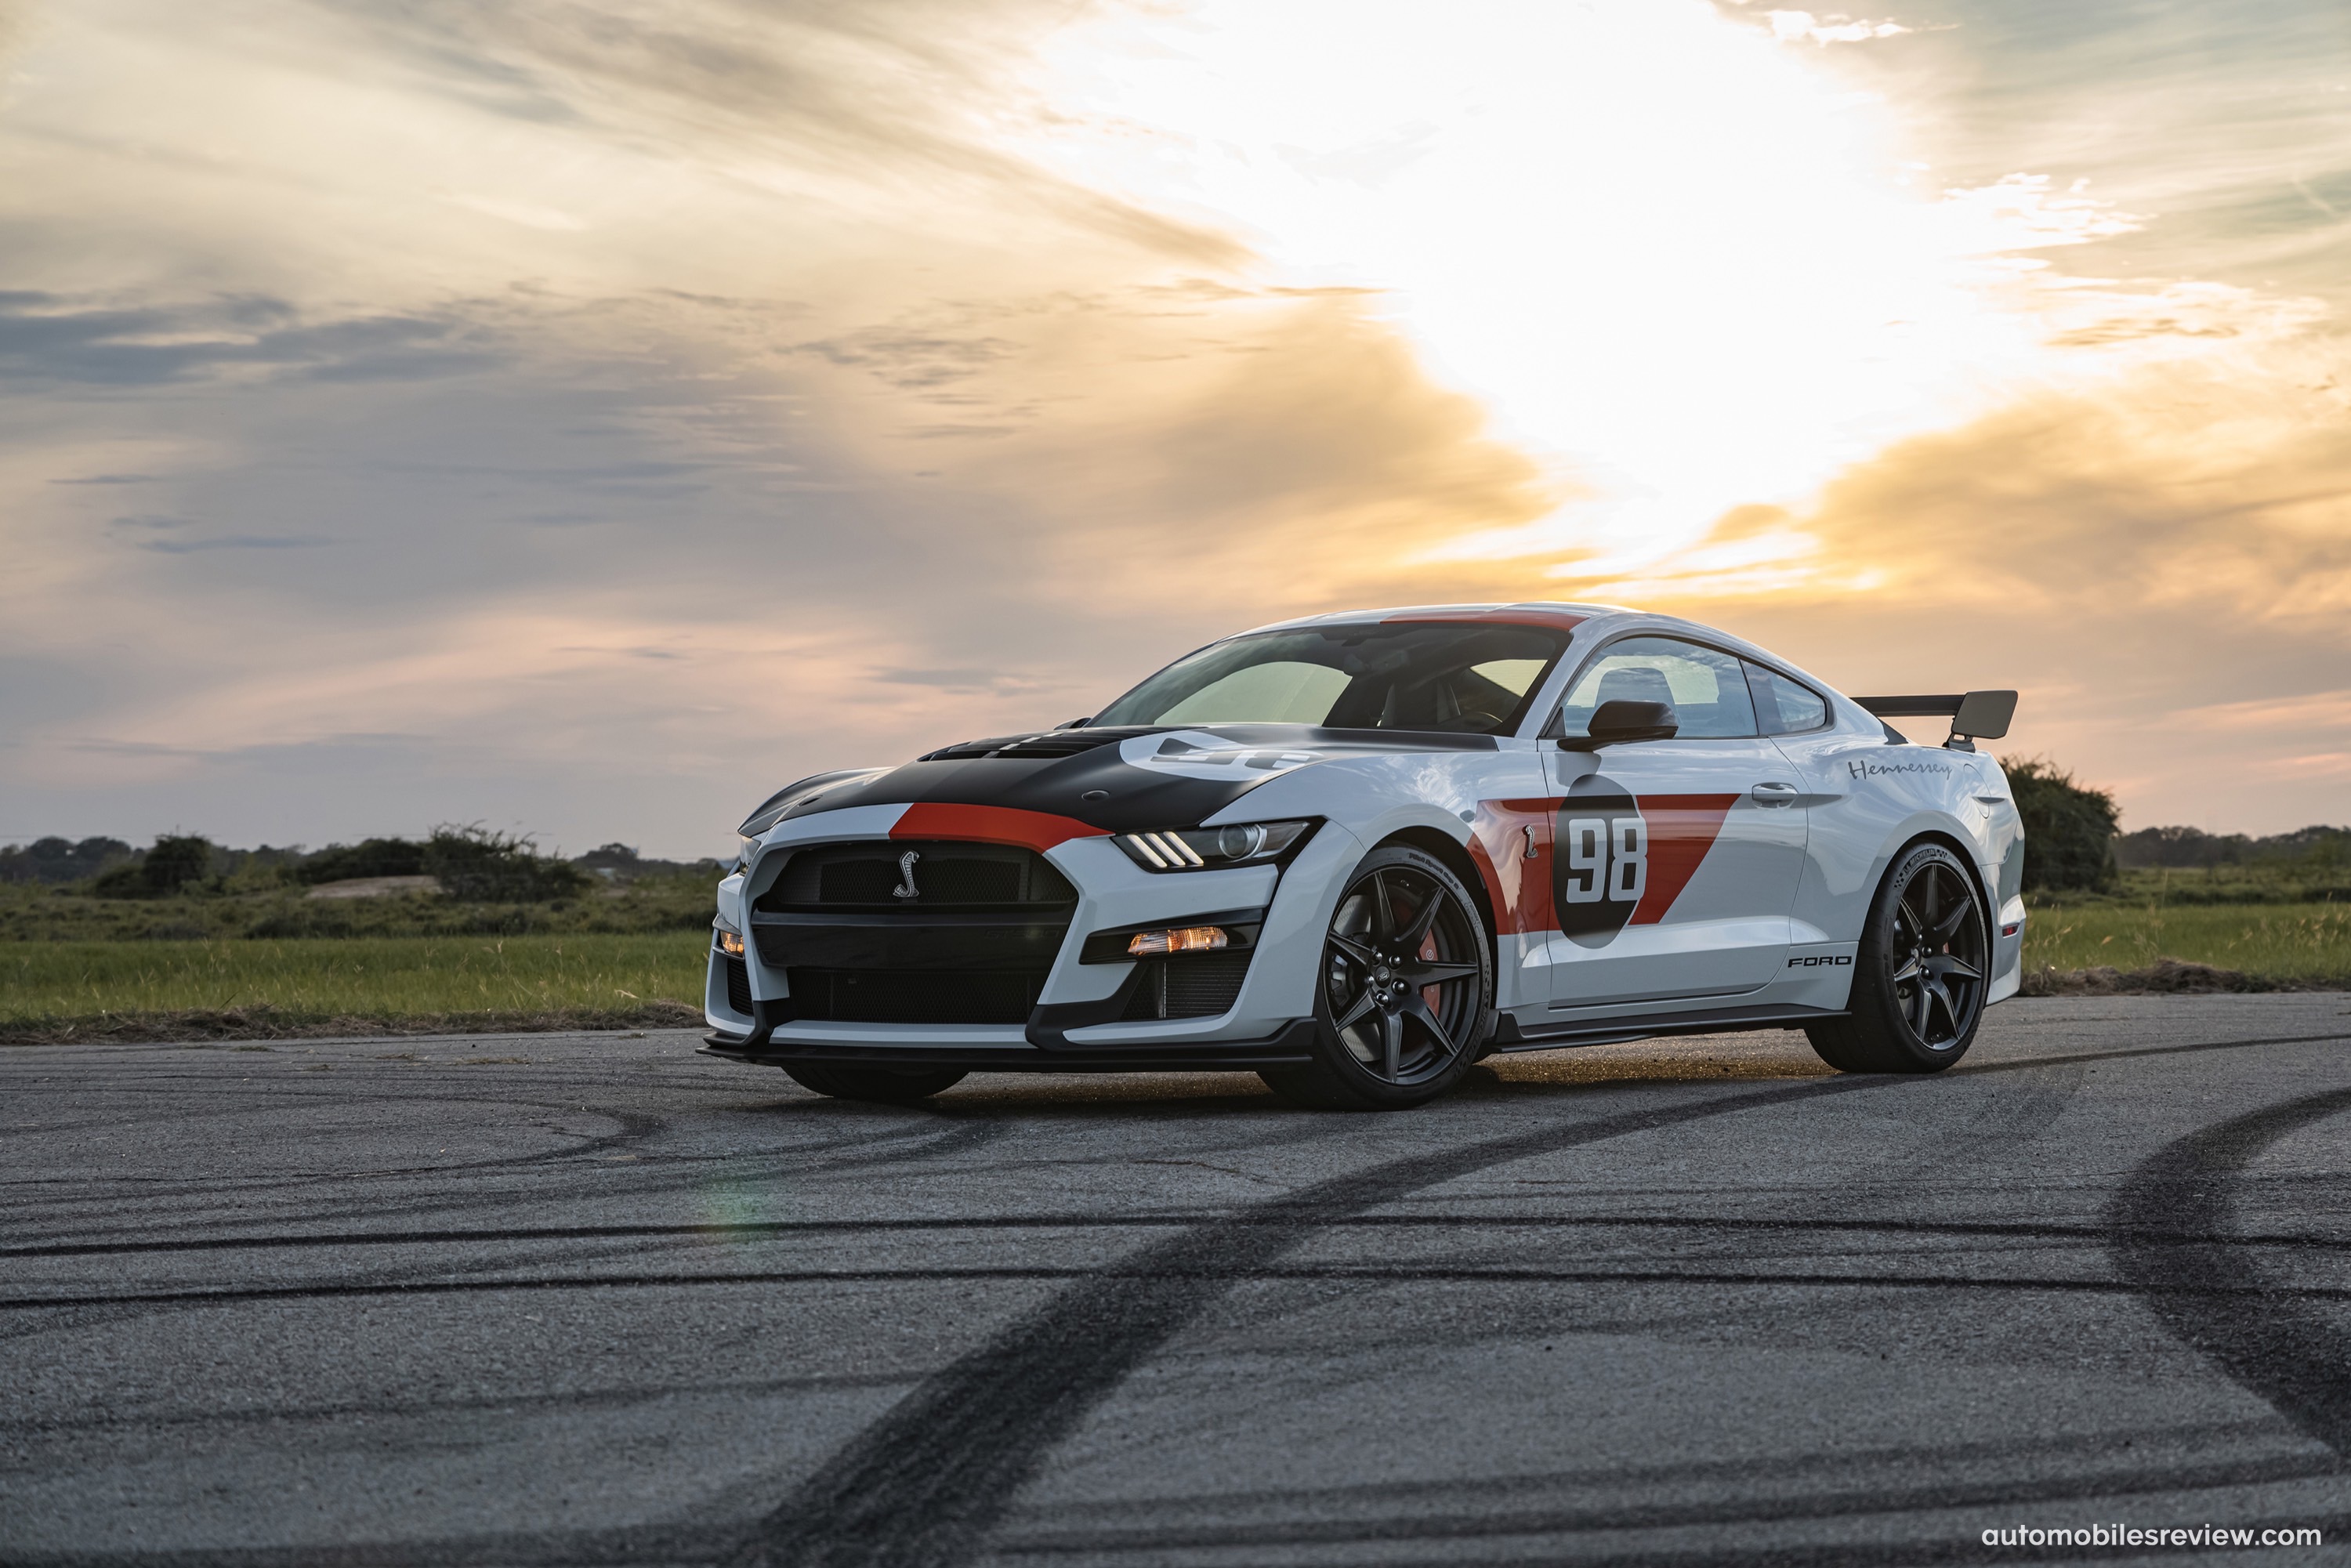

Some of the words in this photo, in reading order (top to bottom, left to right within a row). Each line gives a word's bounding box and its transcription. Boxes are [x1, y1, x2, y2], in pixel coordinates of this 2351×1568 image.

[1848, 760, 1952, 780] Hennessey
[1567, 818, 1648, 904] 98
[1909, 849, 1936, 867] MICHELIN
[1788, 956, 1852, 968] FORD
